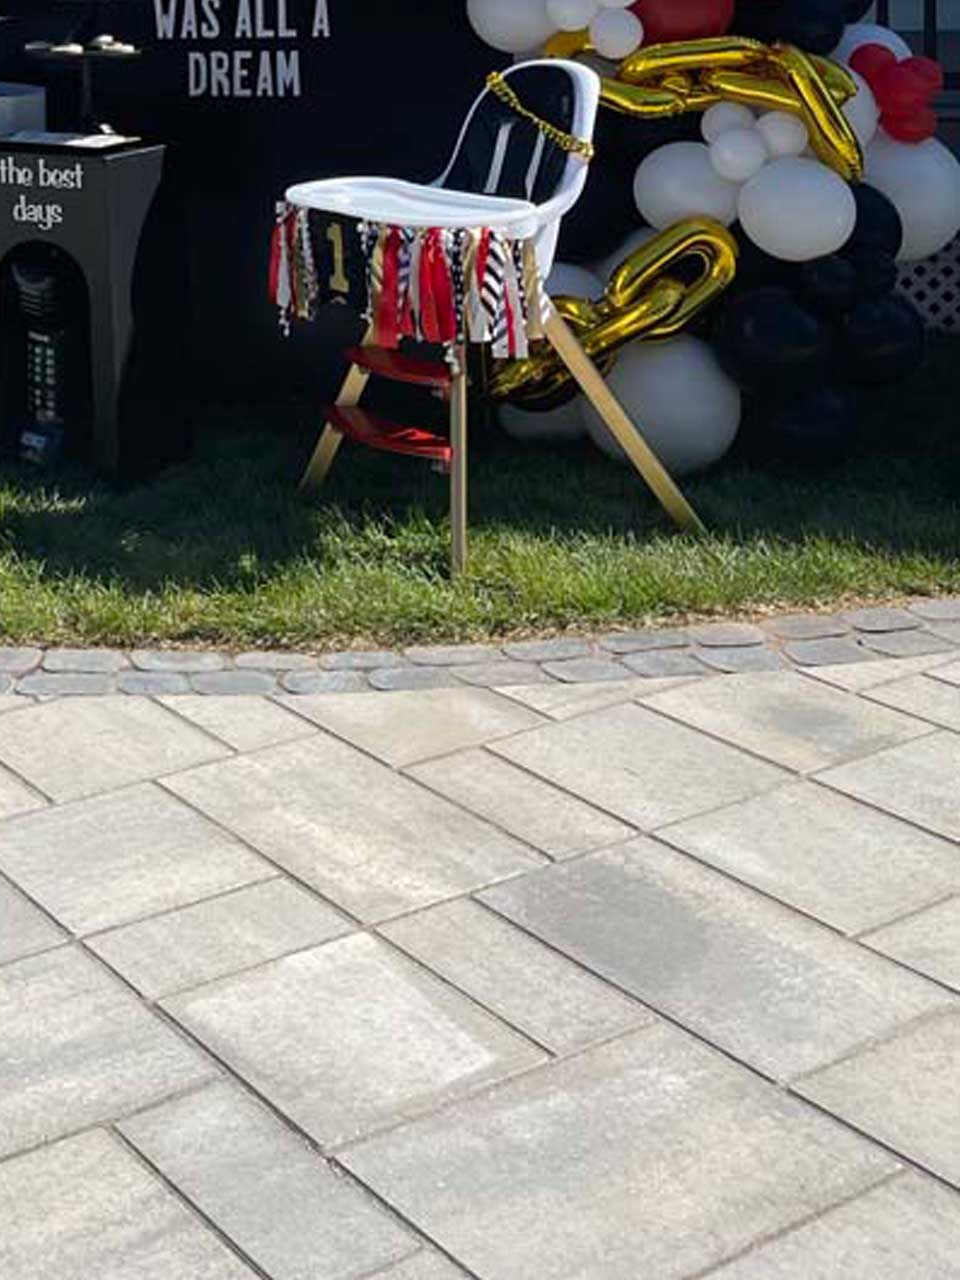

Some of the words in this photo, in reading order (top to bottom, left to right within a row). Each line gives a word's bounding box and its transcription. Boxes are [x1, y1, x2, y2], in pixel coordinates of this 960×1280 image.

[188, 50, 301, 97] DREAM
[38, 158, 84, 189] best
[12, 194, 63, 230] days
[327, 223, 349, 293] 1
